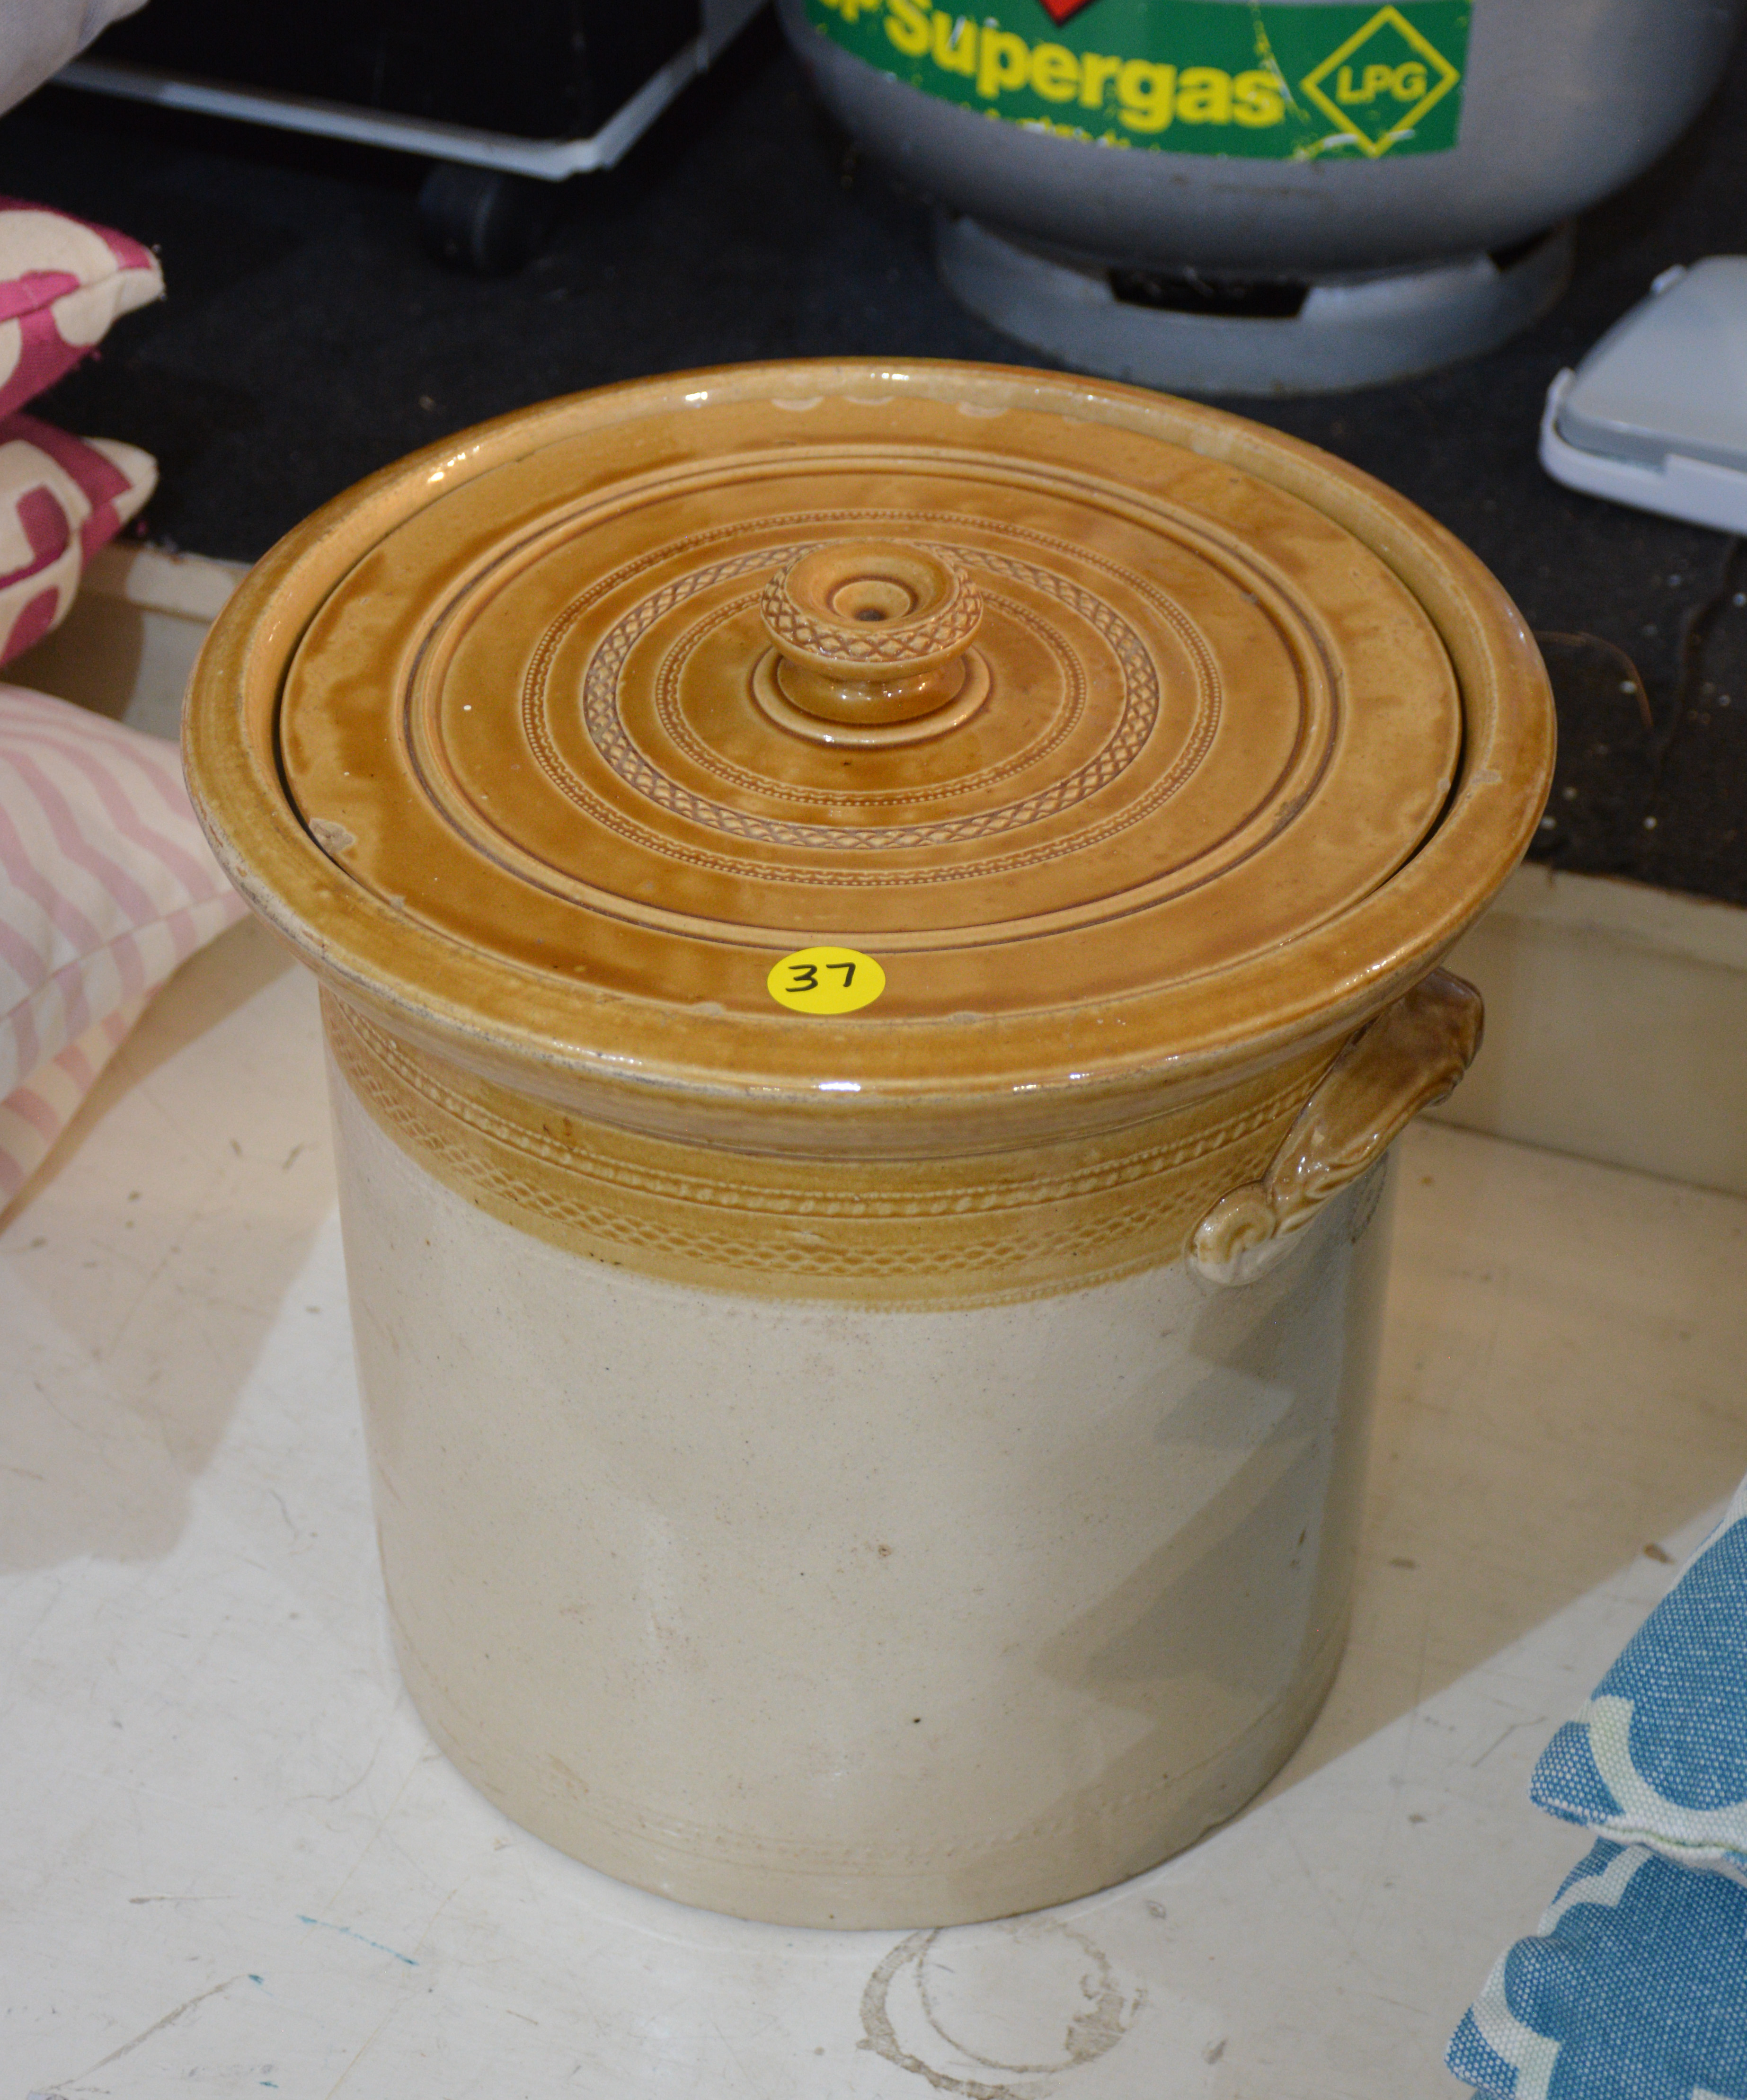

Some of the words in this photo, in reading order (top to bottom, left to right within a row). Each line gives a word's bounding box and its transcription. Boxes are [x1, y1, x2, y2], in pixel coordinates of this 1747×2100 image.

[884, 0, 1285, 133] Supergas
[1337, 62, 1427, 104] LPG
[785, 962, 856, 992] 37
